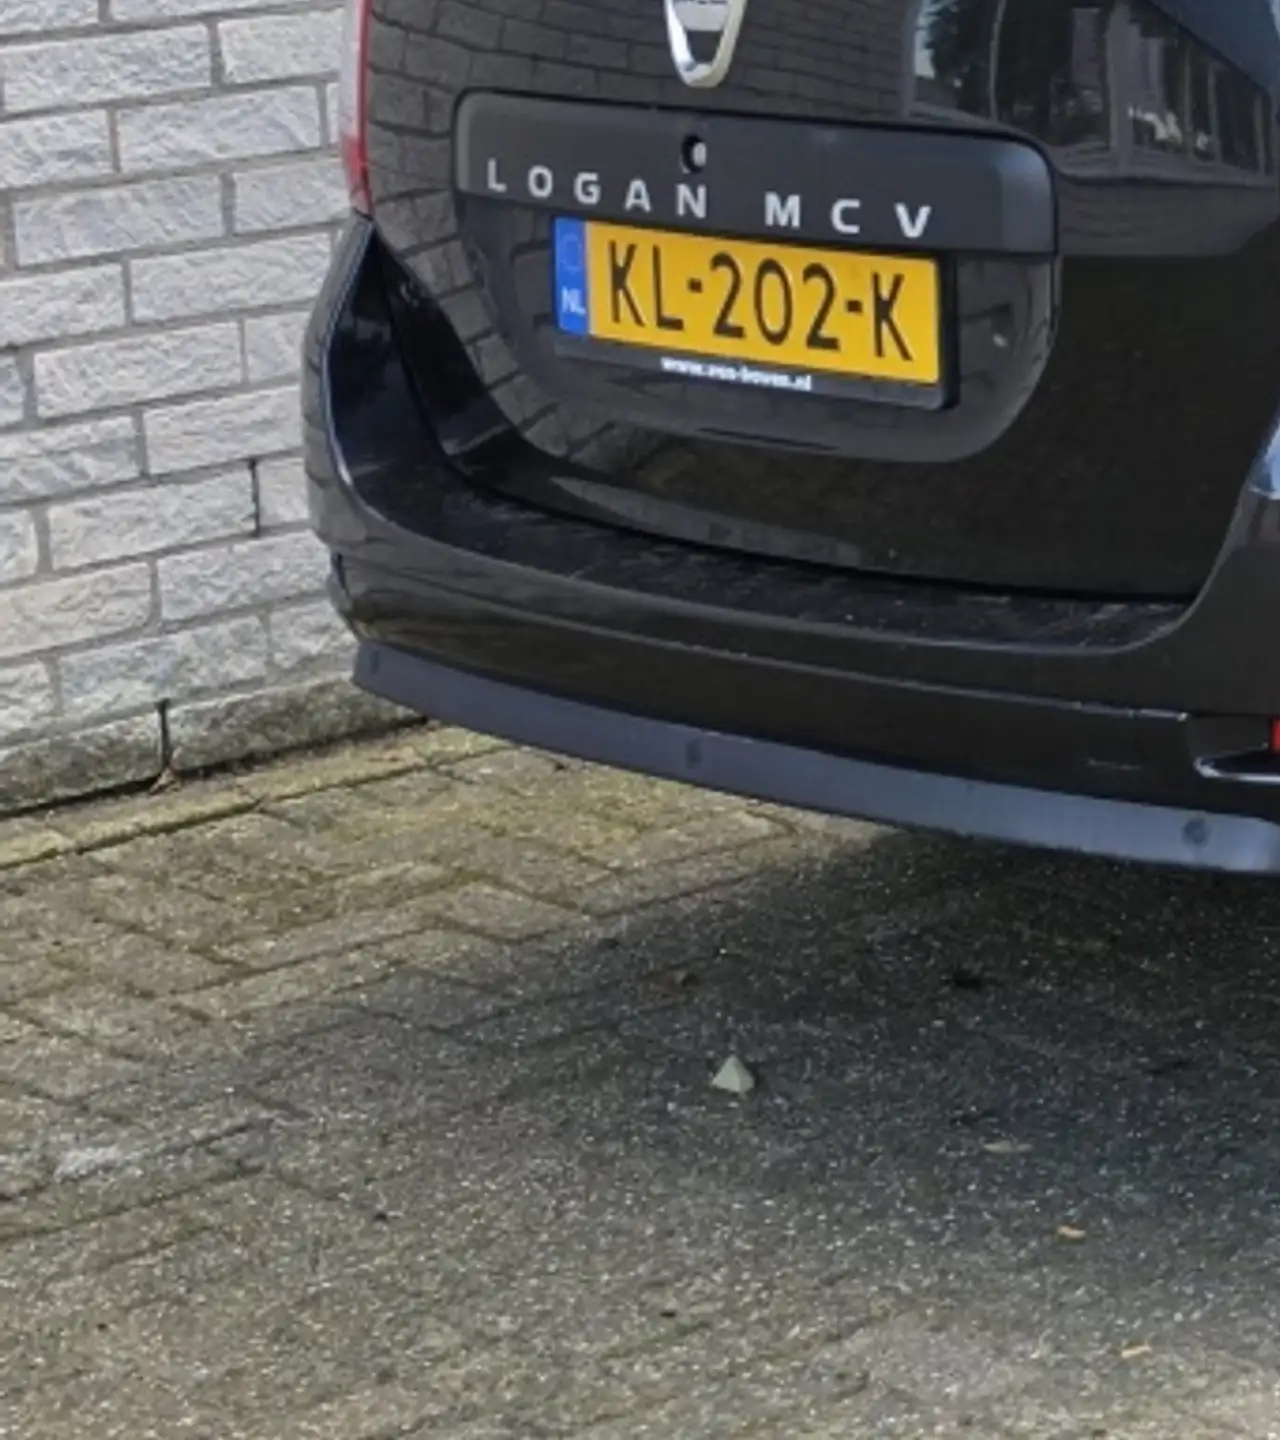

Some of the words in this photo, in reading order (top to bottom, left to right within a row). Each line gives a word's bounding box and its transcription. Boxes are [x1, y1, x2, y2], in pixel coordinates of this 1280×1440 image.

[487, 158, 707, 218] LOGAN
[562, 285, 587, 316] NL
[609, 239, 914, 362] KL-202-K
